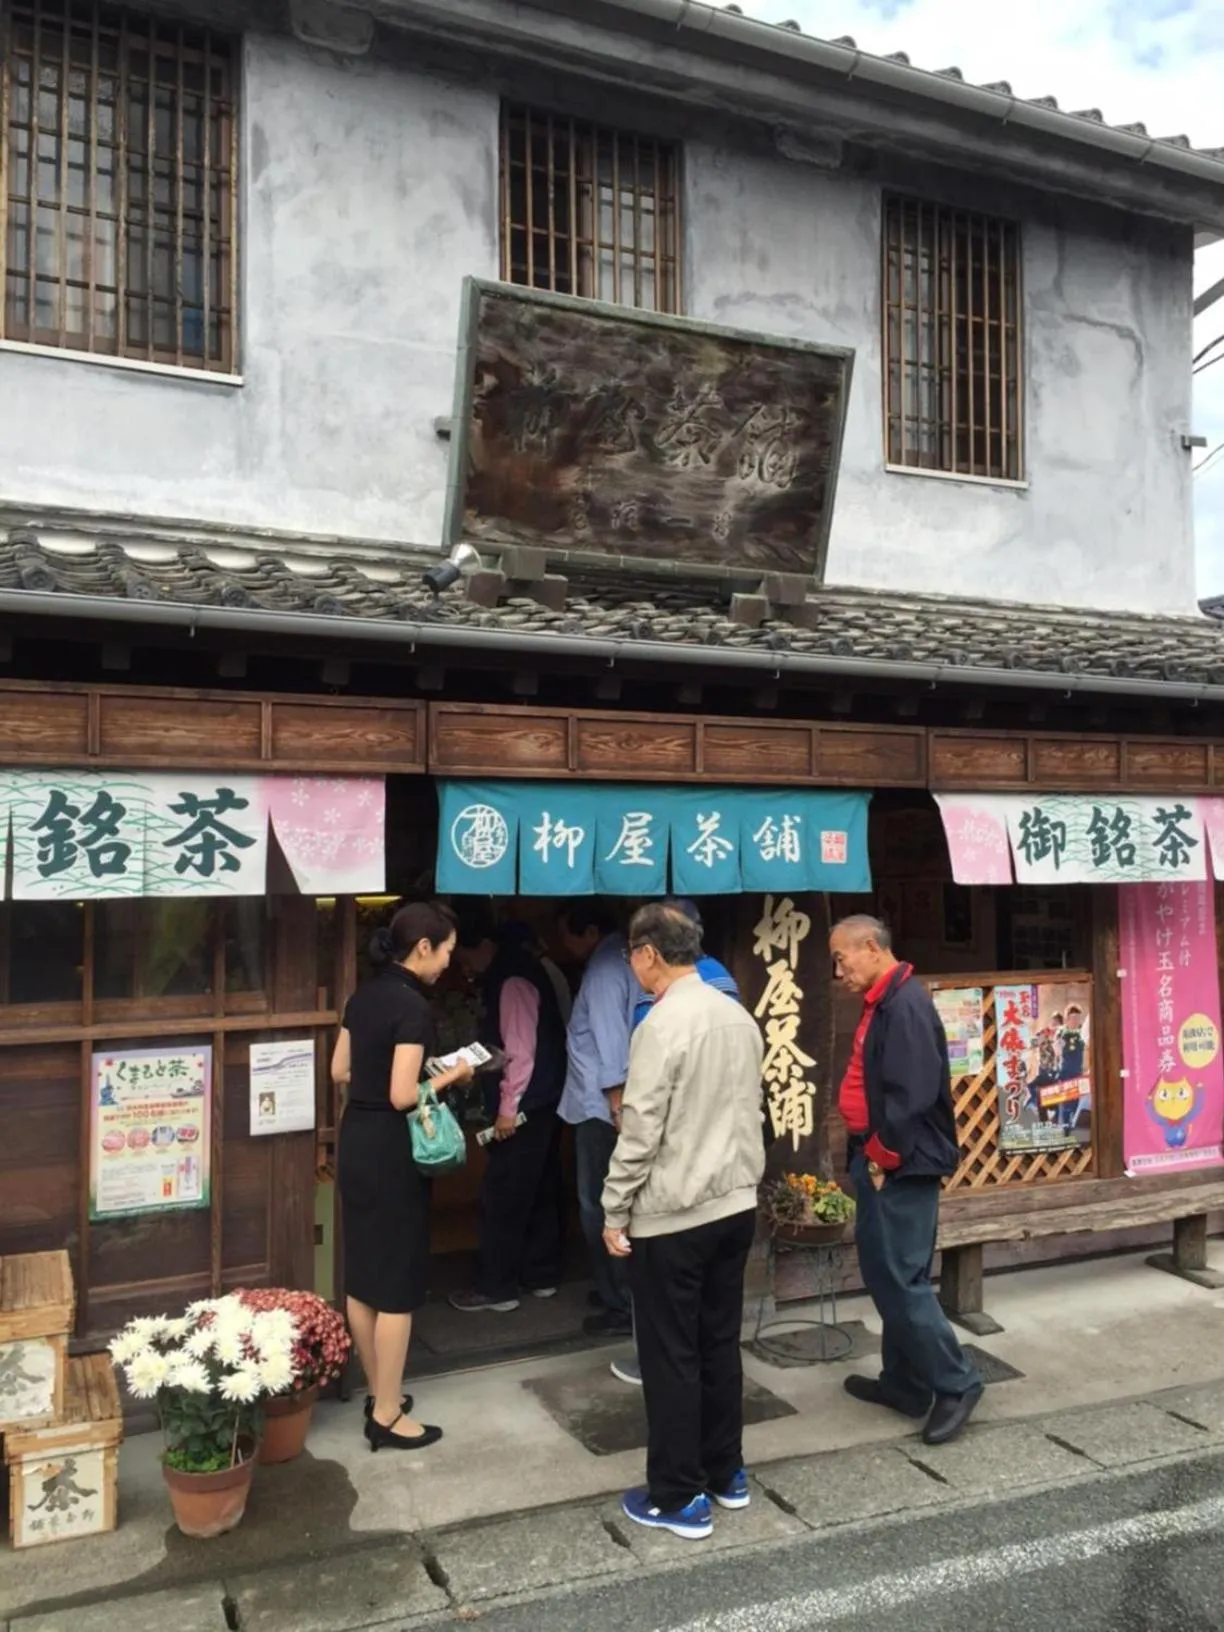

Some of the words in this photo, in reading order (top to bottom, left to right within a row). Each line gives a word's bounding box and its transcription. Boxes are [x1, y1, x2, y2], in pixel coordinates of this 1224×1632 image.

[29, 788, 257, 878] 銘茶
[532, 811, 801, 868] 柳屋茶舗
[1017, 804, 1199, 871] 御銘茶
